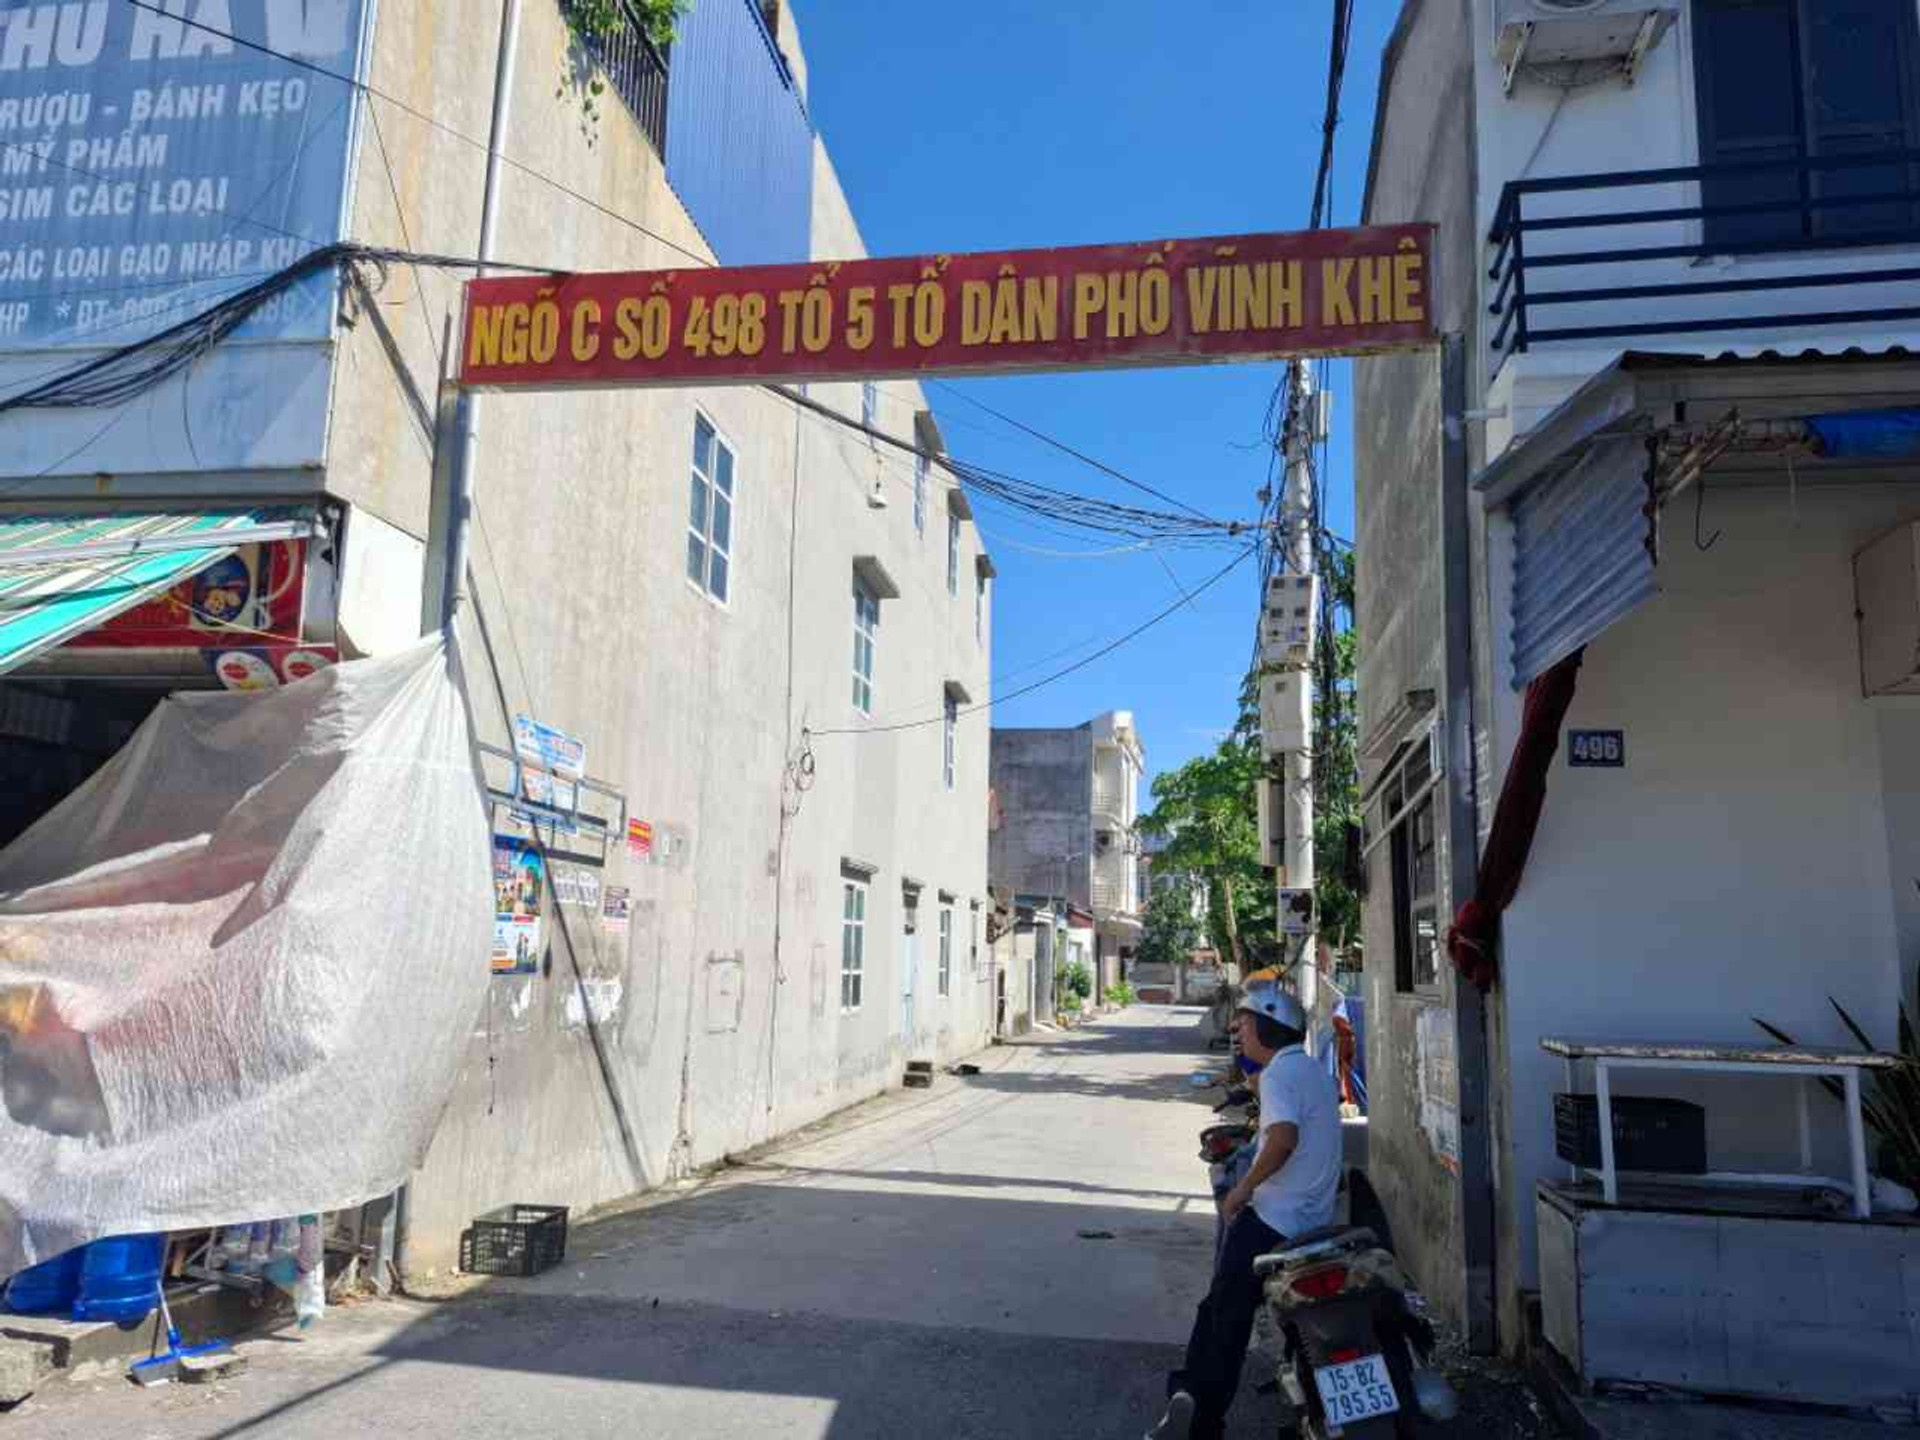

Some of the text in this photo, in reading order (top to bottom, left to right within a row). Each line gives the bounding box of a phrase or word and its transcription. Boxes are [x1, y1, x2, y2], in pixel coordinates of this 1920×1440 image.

[130, 79, 226, 121] BÁNH
[237, 77, 306, 121] KẸO
[66, 124, 168, 170] PHẨM
[66, 175, 138, 217] CÁC
[150, 177, 229, 217] LOẠI
[0, 243, 45, 280] CÁC
[53, 246, 110, 284] LOẠI
[120, 241, 172, 282] GẠO
[180, 232, 251, 278] NHẬP
[469, 237, 1424, 366] NGÕ C SỐ 498 TỔ 5 TỔ DÂN PHỐ VĨNH KHÊ
[1573, 735, 1619, 760] 496
